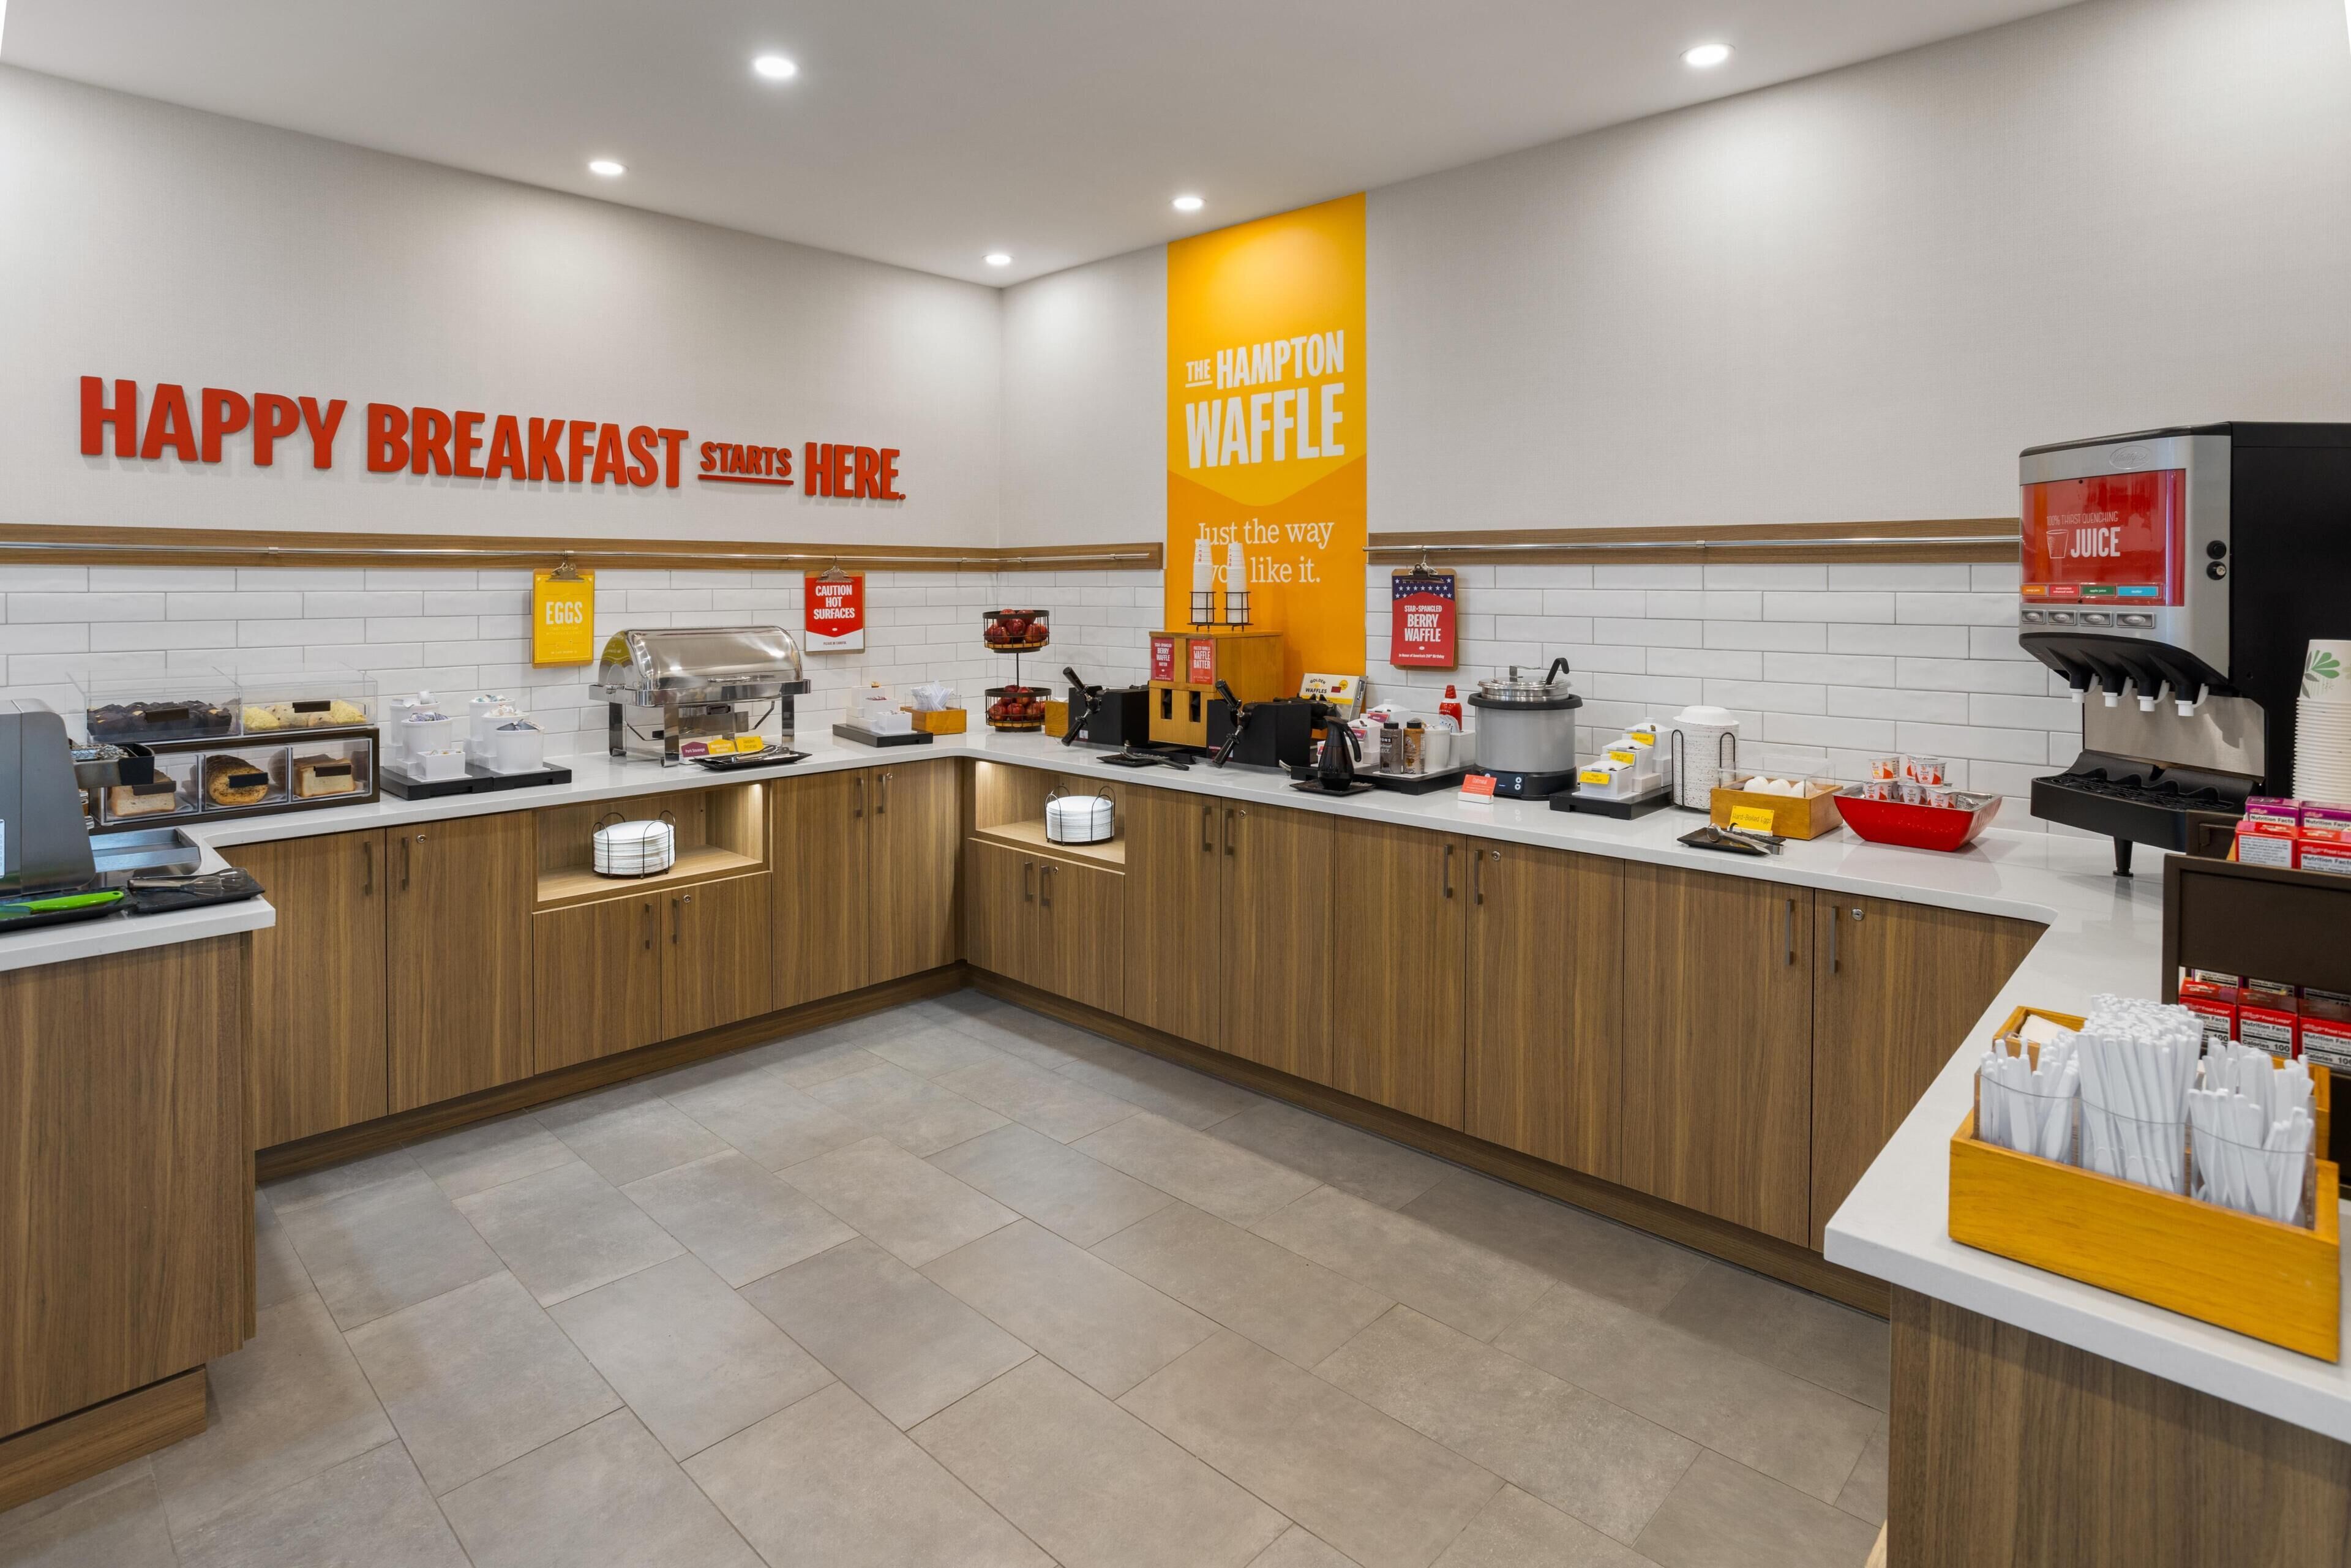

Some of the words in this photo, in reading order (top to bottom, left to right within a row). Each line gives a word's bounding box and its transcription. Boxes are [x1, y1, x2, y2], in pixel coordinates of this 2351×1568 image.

[1186, 358, 1211, 382] THE
[1217, 329, 1344, 390] HAMPTON
[1185, 382, 1345, 469] WAFFLE
[80, 375, 348, 469] HAPPY
[367, 402, 689, 488] BREAKFAST
[700, 441, 793, 477] STARTS
[804, 441, 907, 501] HERE.
[2047, 515, 2060, 525] 100%
[2061, 514, 2081, 525] THIRST
[2082, 511, 2118, 524] QUENCHING
[1198, 521, 1239, 546] Just
[1243, 517, 1280, 544] the
[1285, 522, 1335, 550] way
[2071, 527, 2121, 558] JUICE
[1250, 556, 1292, 583] like
[1299, 555, 1321, 583] it.
[816, 585, 853, 596] CAUTION
[825, 596, 842, 607] HOT
[546, 601, 583, 625] EGGS
[813, 607, 855, 620] SURFACES
[1408, 613, 1439, 628] BERRY
[1404, 628, 1441, 642] WAFFLE
[1193, 650, 1210, 660] WAFFLE
[1193, 659, 1210, 669] BATTER
[1733, 813, 1760, 822] Hard-Boiled
[1761, 816, 1772, 825] Eggs
[2242, 1020, 2270, 1029] Nutrition
[2304, 1033, 2333, 1043] Nutrition
[2243, 1040, 2270, 1049] Calories
[2274, 1043, 2290, 1052] 100
